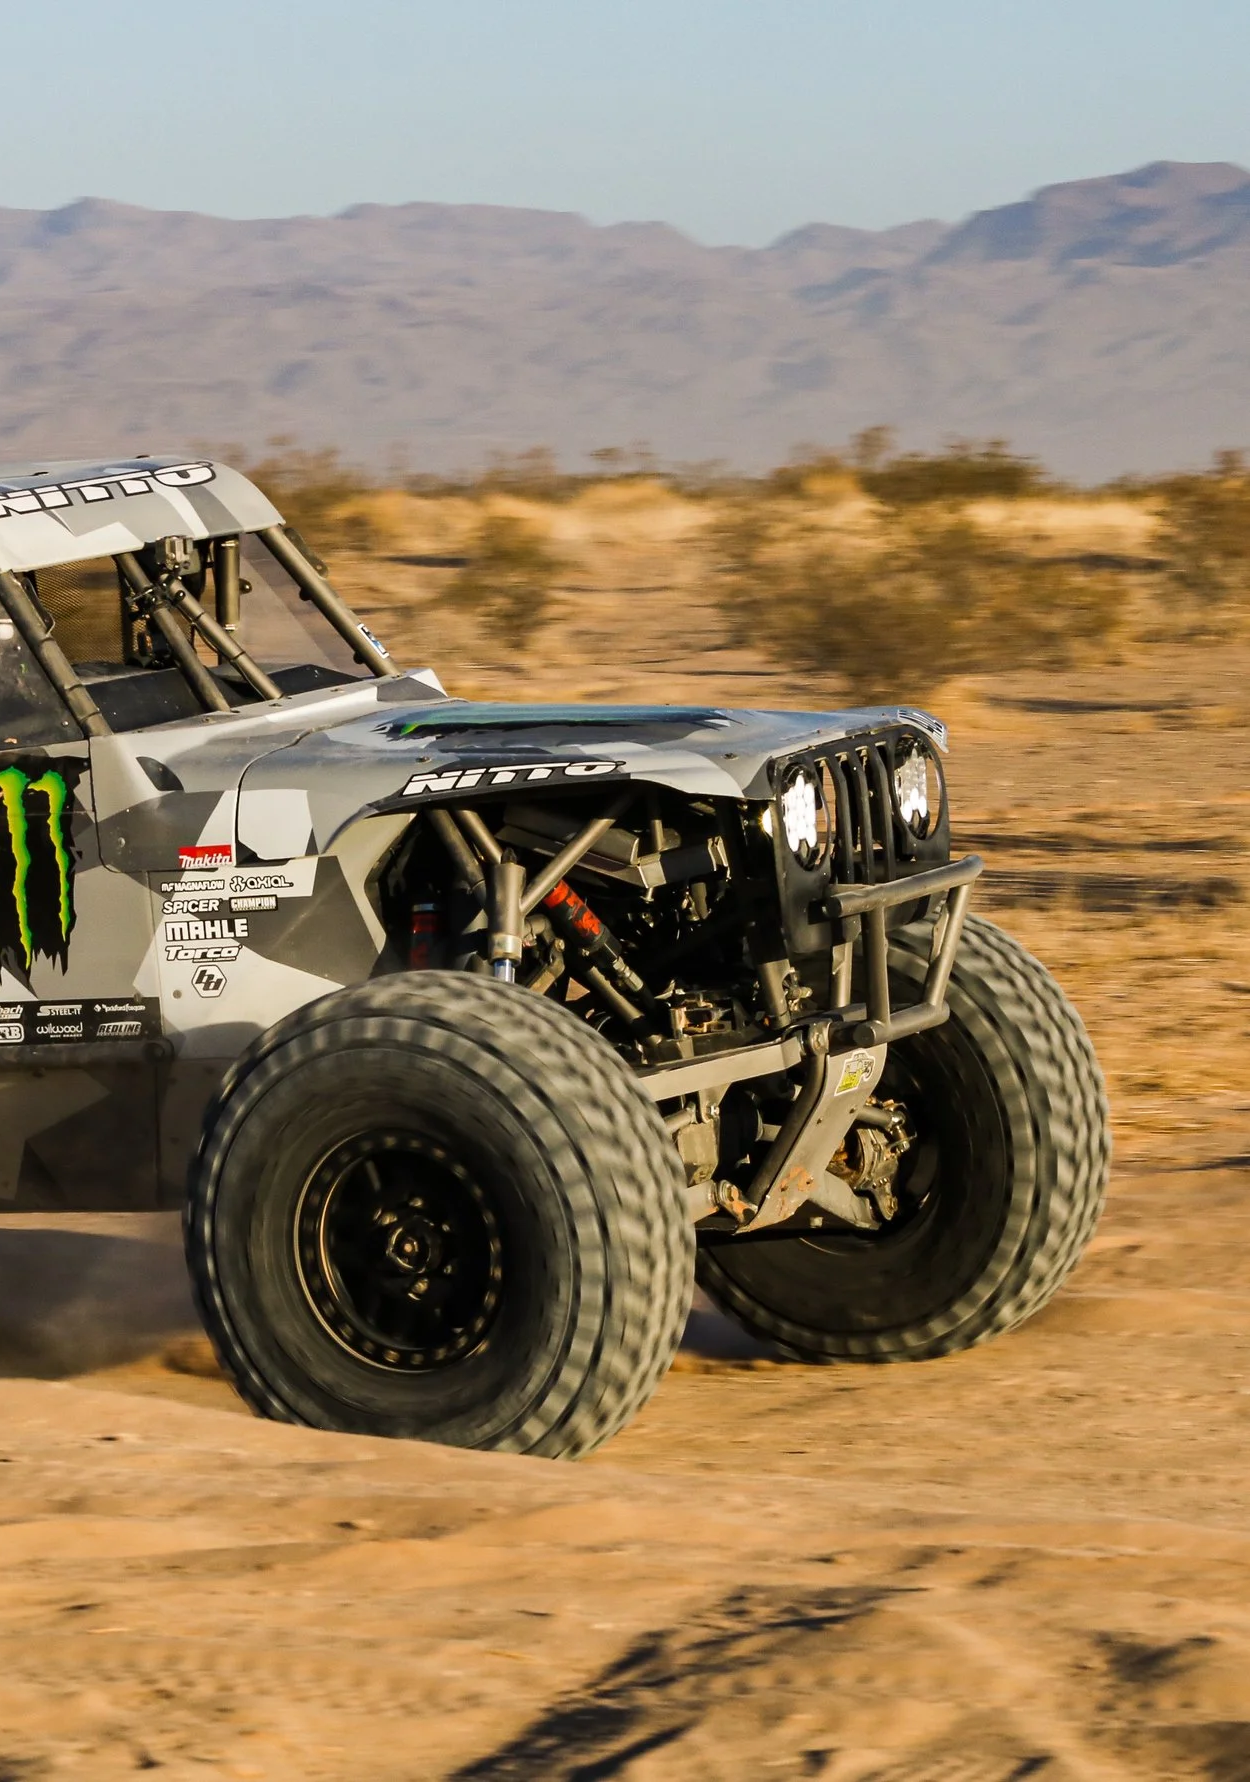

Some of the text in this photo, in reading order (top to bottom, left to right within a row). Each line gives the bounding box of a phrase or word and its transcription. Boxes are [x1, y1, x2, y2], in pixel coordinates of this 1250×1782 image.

[402, 761, 618, 797] NITTO
[173, 880, 225, 891] MAGNAFLOW
[163, 899, 220, 913] SPICER
[231, 897, 276, 909] CHAMPION
[166, 918, 248, 941] MAHLE
[165, 945, 240, 961] Torco
[36, 1022, 83, 1034] wilwood
[98, 1023, 141, 1033] REDLINE
